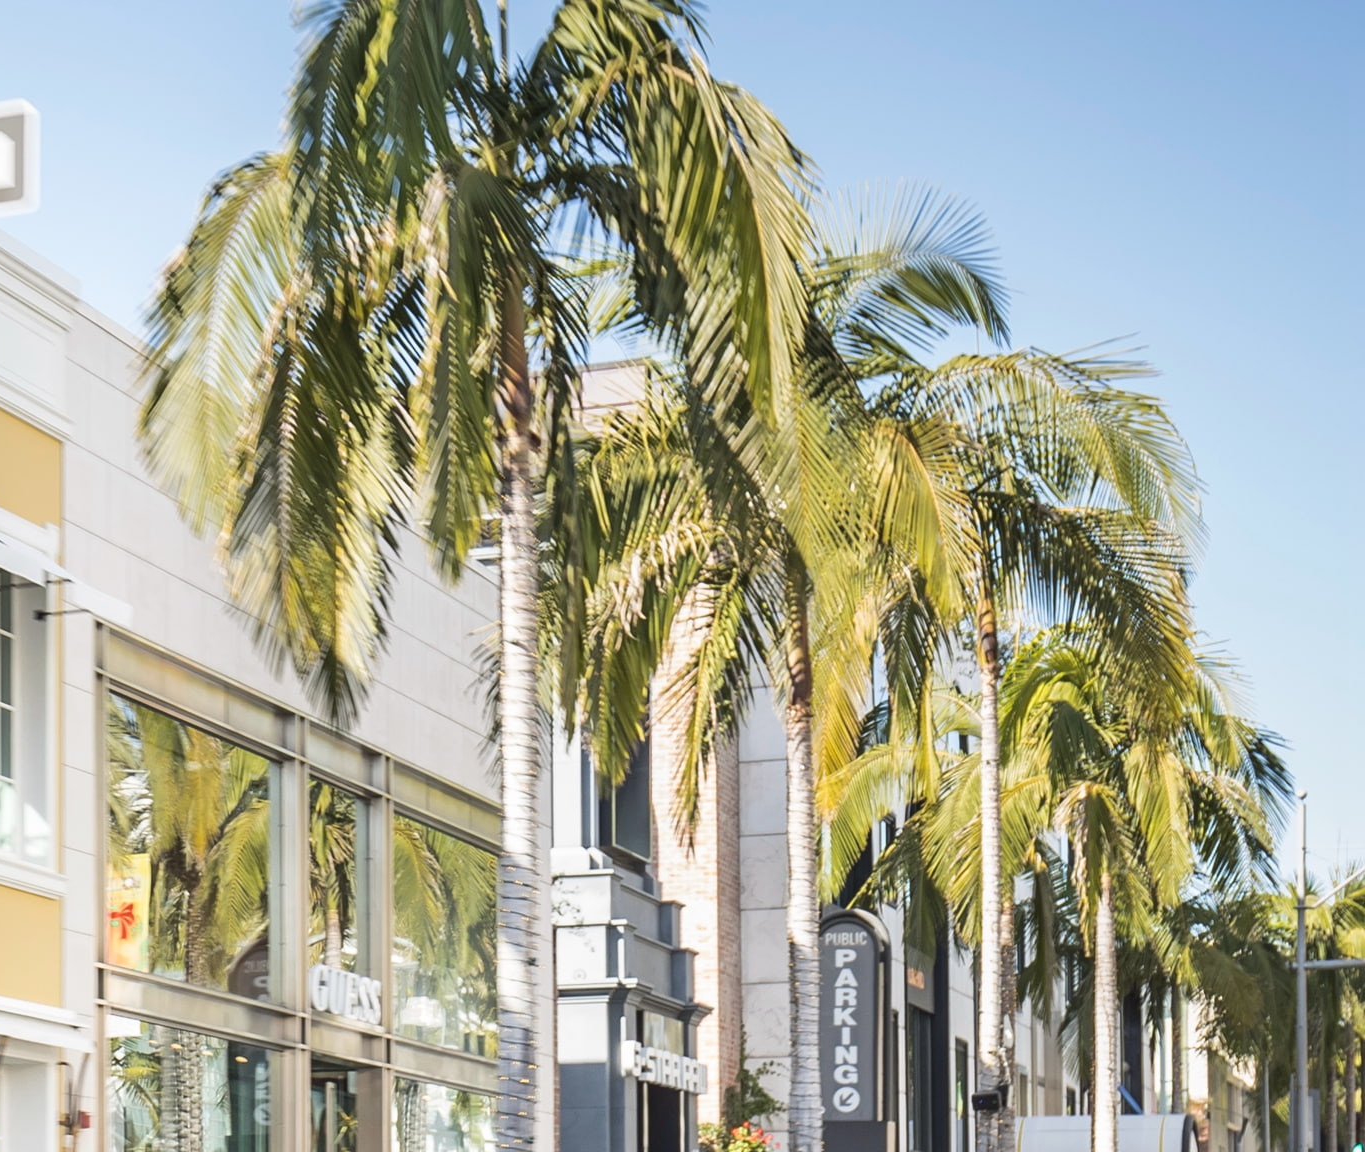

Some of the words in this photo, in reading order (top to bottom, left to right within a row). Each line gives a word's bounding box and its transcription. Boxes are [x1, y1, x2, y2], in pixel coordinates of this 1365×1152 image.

[825, 931, 868, 946] PUBLIC
[309, 963, 382, 1026] GUESS
[833, 949, 859, 1085] PARKING
